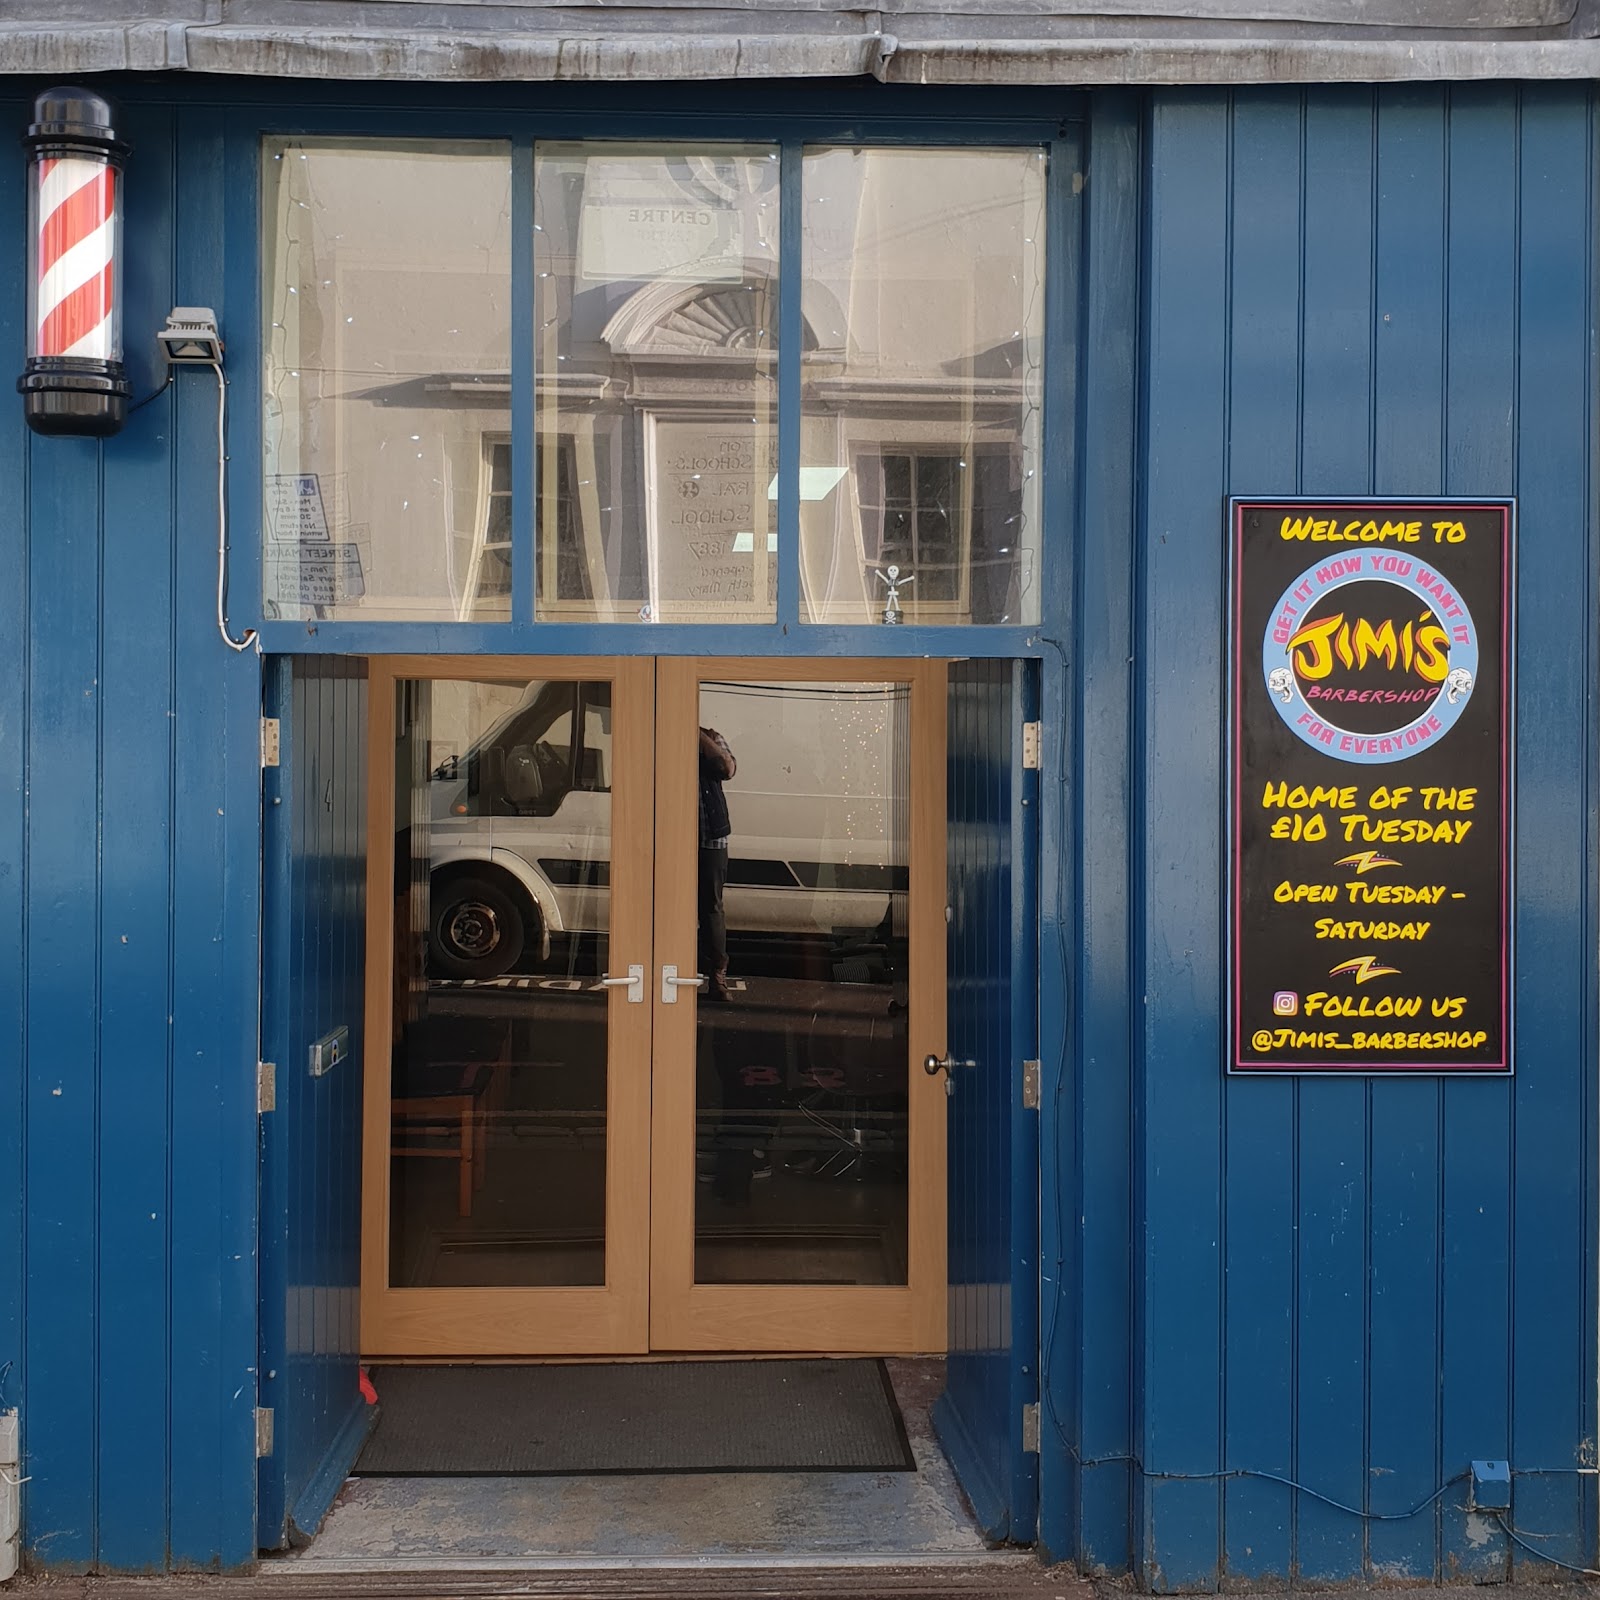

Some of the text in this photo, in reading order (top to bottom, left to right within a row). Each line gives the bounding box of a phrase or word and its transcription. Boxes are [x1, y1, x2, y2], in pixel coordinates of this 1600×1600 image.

[1280, 516, 1467, 543] WELCOME TO
[1272, 556, 1470, 645] GET IT HOW YOU WANT IT
[1306, 685, 1440, 703] BARBERSHOP
[1297, 712, 1443, 754] FOR EVERYONE
[1262, 781, 1478, 810] HOME OF THE
[1270, 813, 1472, 843] £10 TUESDAY
[1273, 881, 1338, 903] OPEN
[1345, 881, 1446, 904] TUESDAY
[1314, 918, 1431, 940] SATURDAY
[1304, 992, 1467, 1018] FOLLOW US
[1252, 1029, 1487, 1052] @JIMIS_BARBERSHOP
